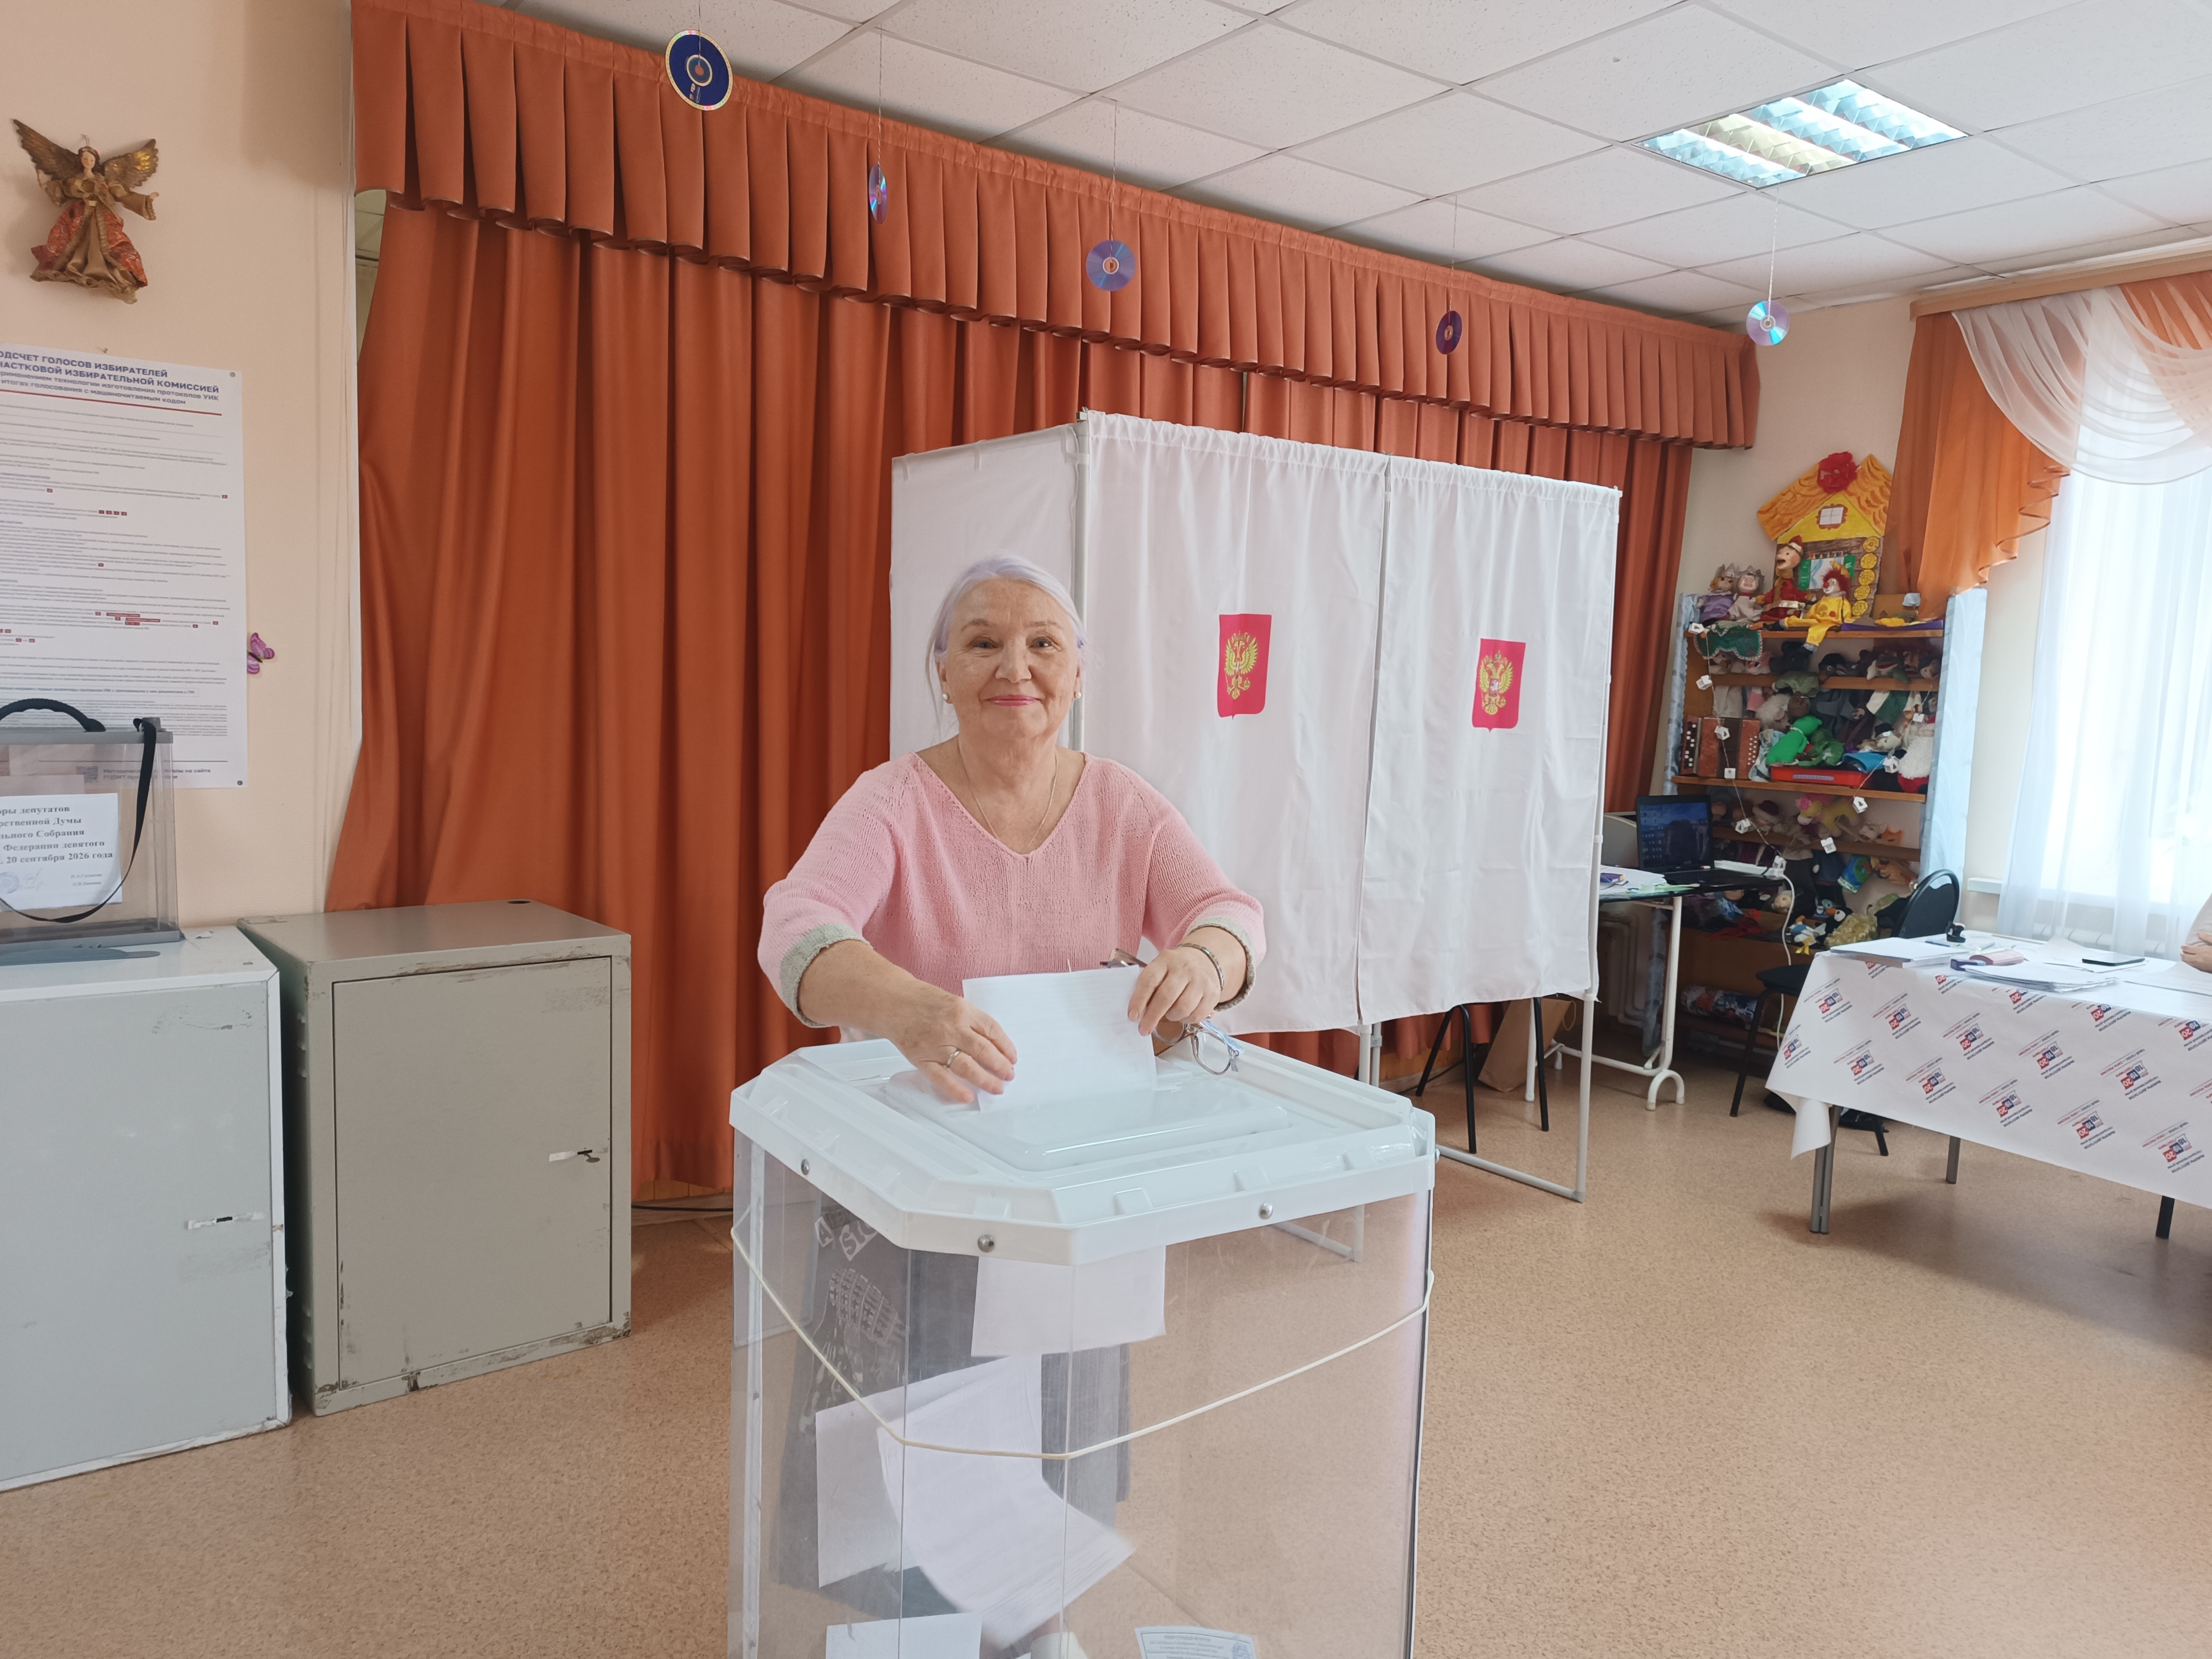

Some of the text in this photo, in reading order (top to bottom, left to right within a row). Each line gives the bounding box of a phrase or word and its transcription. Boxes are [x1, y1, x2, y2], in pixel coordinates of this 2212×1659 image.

[42, 356, 92, 368] ГОЛОСОВ
[95, 363, 168, 378] ИЗБИРАТЕЛЕЙ
[65, 368, 154, 386] ИЗБИРАТЕЛЬНОЙ
[157, 380, 219, 393] КОМИССИЕЙ
[30, 382, 82, 393] голосования
[91, 390, 160, 402] машиночитаемым
[54, 377, 100, 387] технологии
[102, 383, 155, 394] изготовления
[157, 390, 201, 399] протоколов
[19, 807, 70, 815] депутатов
[53, 817, 81, 826] Думы
[36, 830, 85, 838] Собрания
[3, 841, 105, 852] Федерации девятого
[20, 854, 65, 863] сентября
[2011, 993, 2021, 1001] 20
[1819, 1003, 1830, 1011] 20
[2093, 1009, 2103, 1019] 20
[1890, 1019, 1898, 1027] 20
[2181, 1020, 2199, 1037] 19 20
[1961, 1040, 1970, 1048] 20
[2038, 1058, 2048, 1067] 20
[1852, 1065, 1861, 1073] 20
[2122, 1078, 2133, 1087] 20
[1923, 1083, 1933, 1092] 20
[1997, 1106, 2007, 1115] 20
[2078, 1127, 2089, 1136] 20
[2165, 1138, 2187, 1160] 18 19 20
